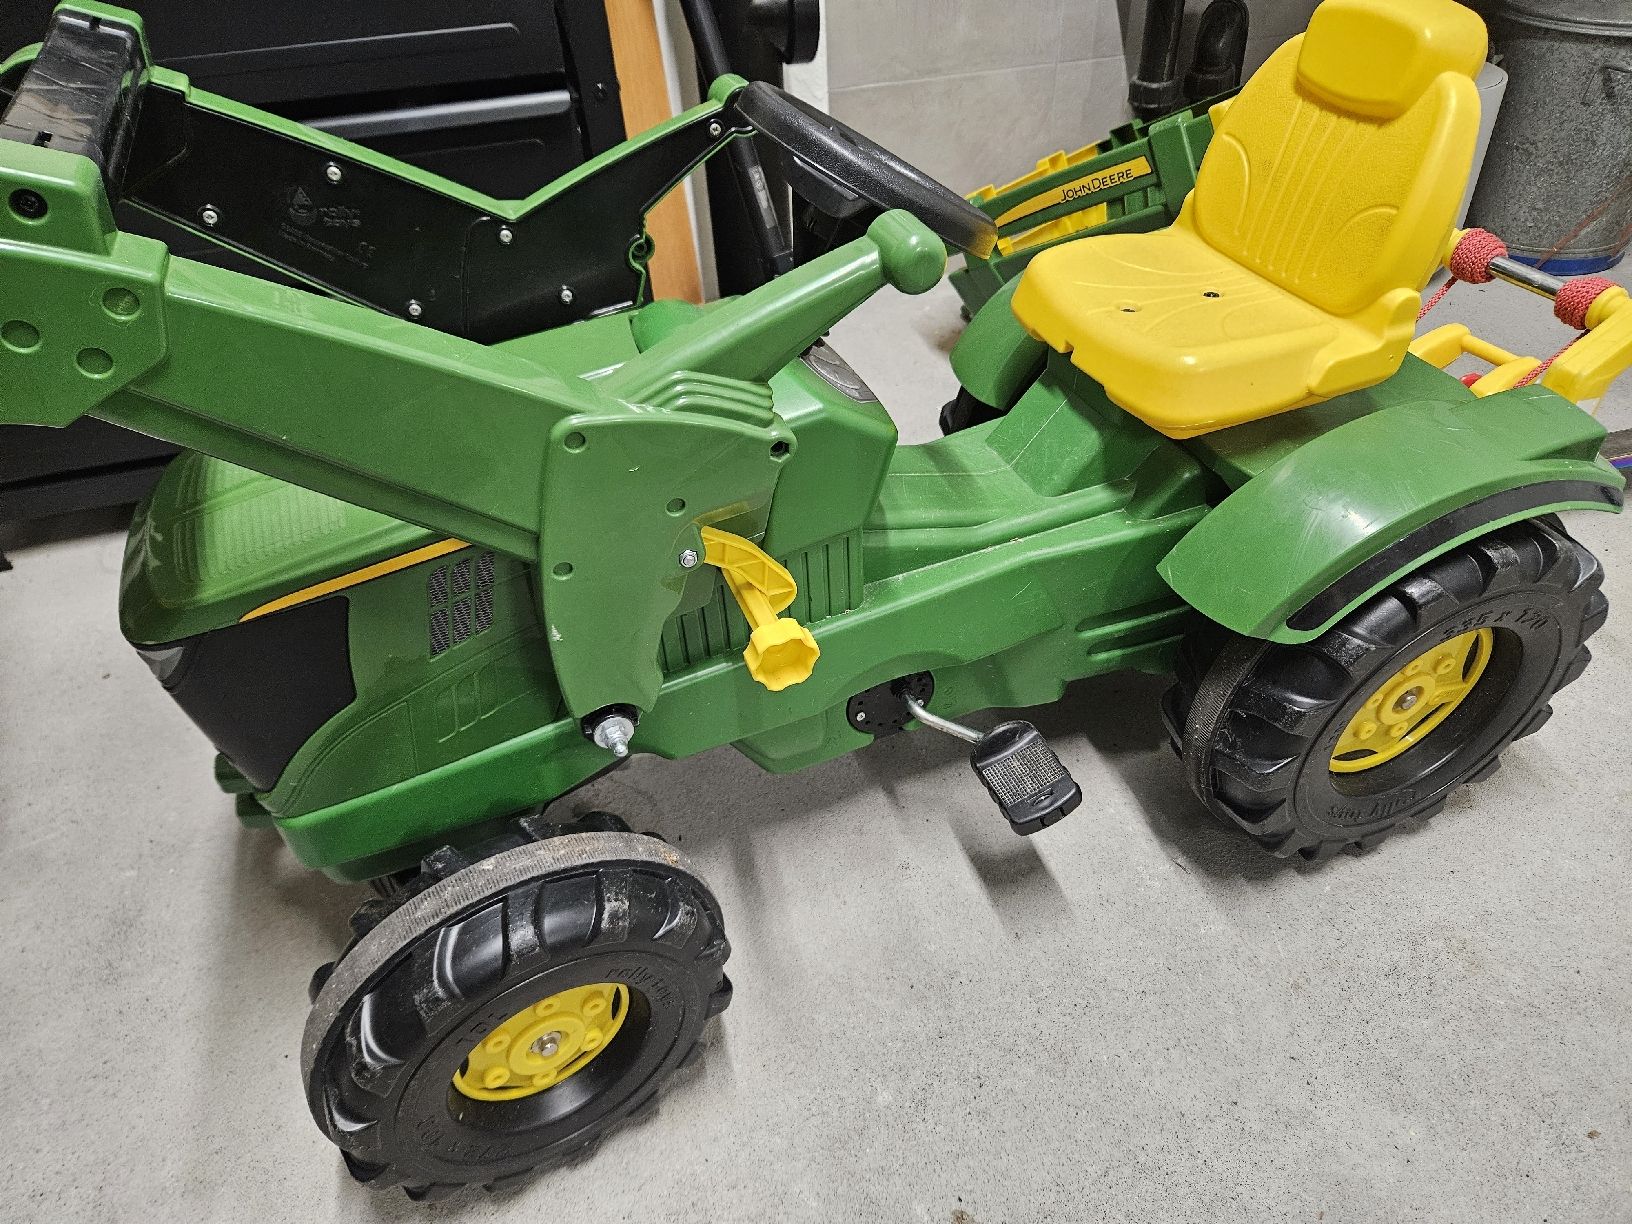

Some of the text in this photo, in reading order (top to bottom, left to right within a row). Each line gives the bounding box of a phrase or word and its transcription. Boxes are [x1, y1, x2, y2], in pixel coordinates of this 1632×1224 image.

[1061, 169, 1134, 201] JOHN DEERE
[604, 966, 653, 985] rolly
